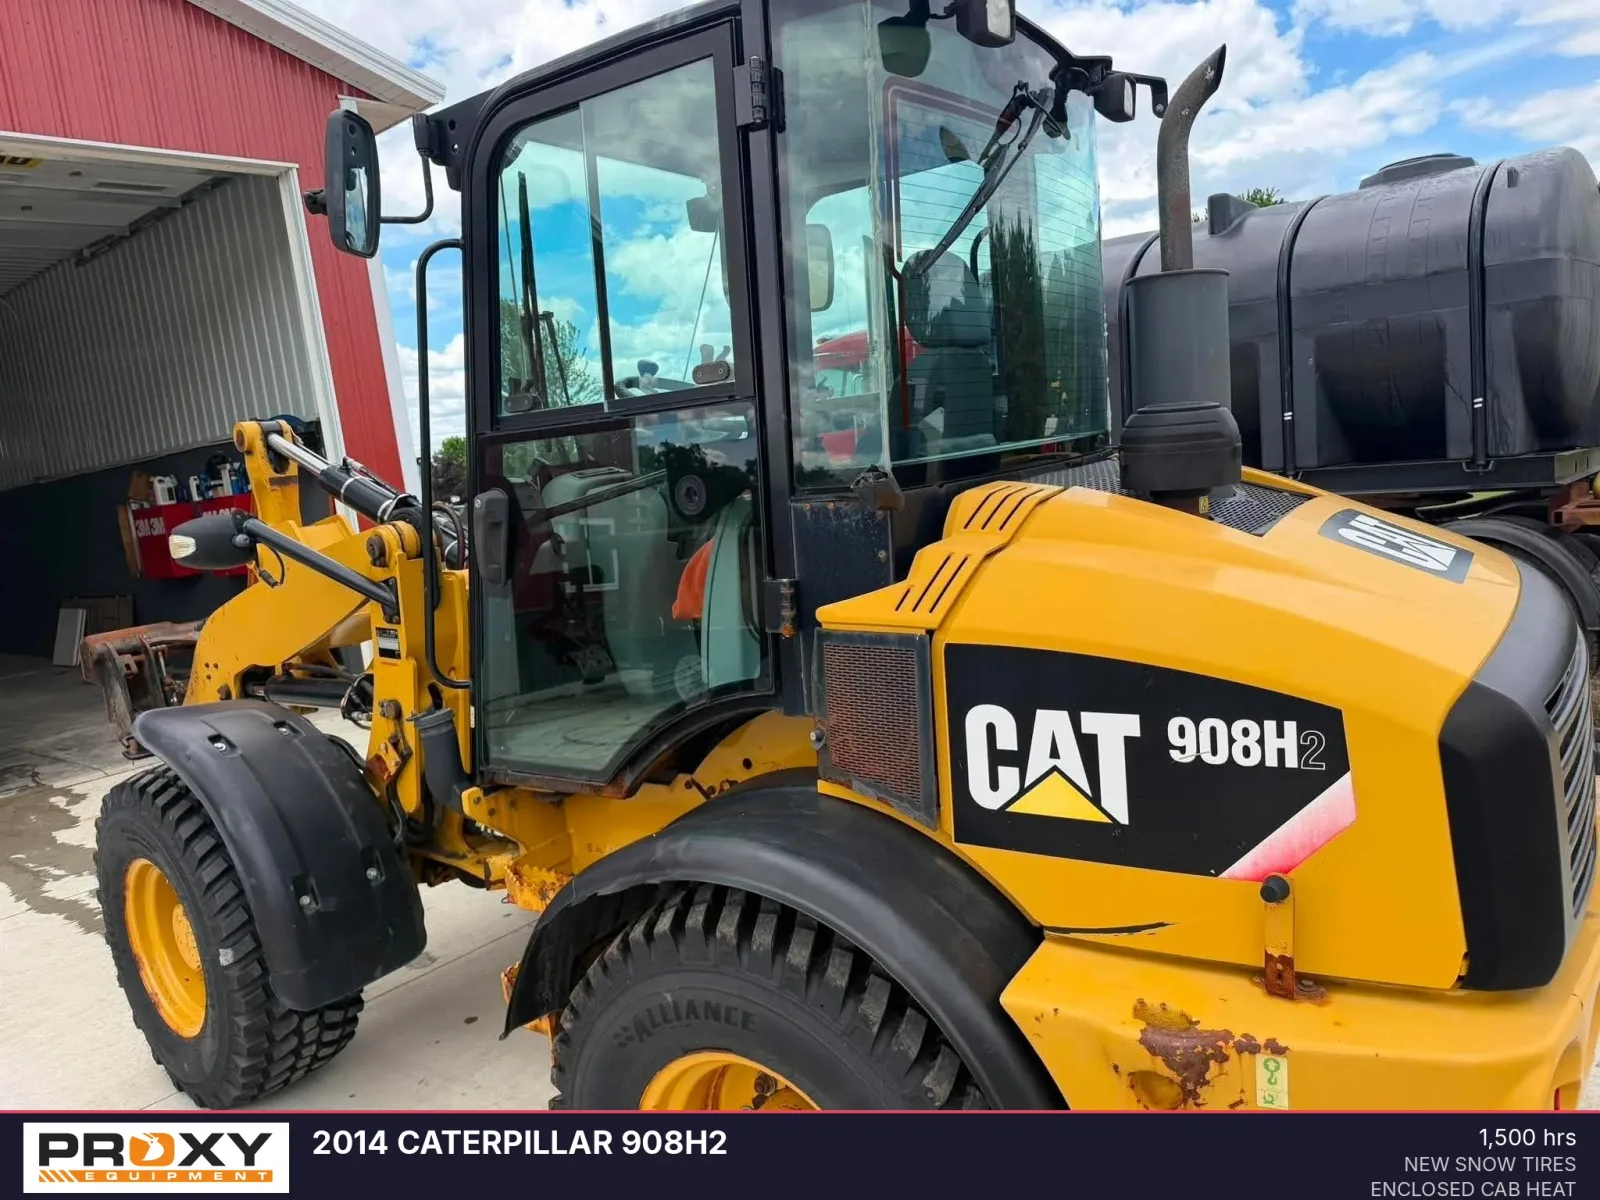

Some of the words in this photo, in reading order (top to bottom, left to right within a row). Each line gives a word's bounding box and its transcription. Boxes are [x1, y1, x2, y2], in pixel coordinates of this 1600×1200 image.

[1338, 514, 1457, 571] CAT
[964, 704, 1141, 825] CAT
[1167, 716, 1326, 770] 908H2
[632, 998, 757, 1043] ALLIANCE
